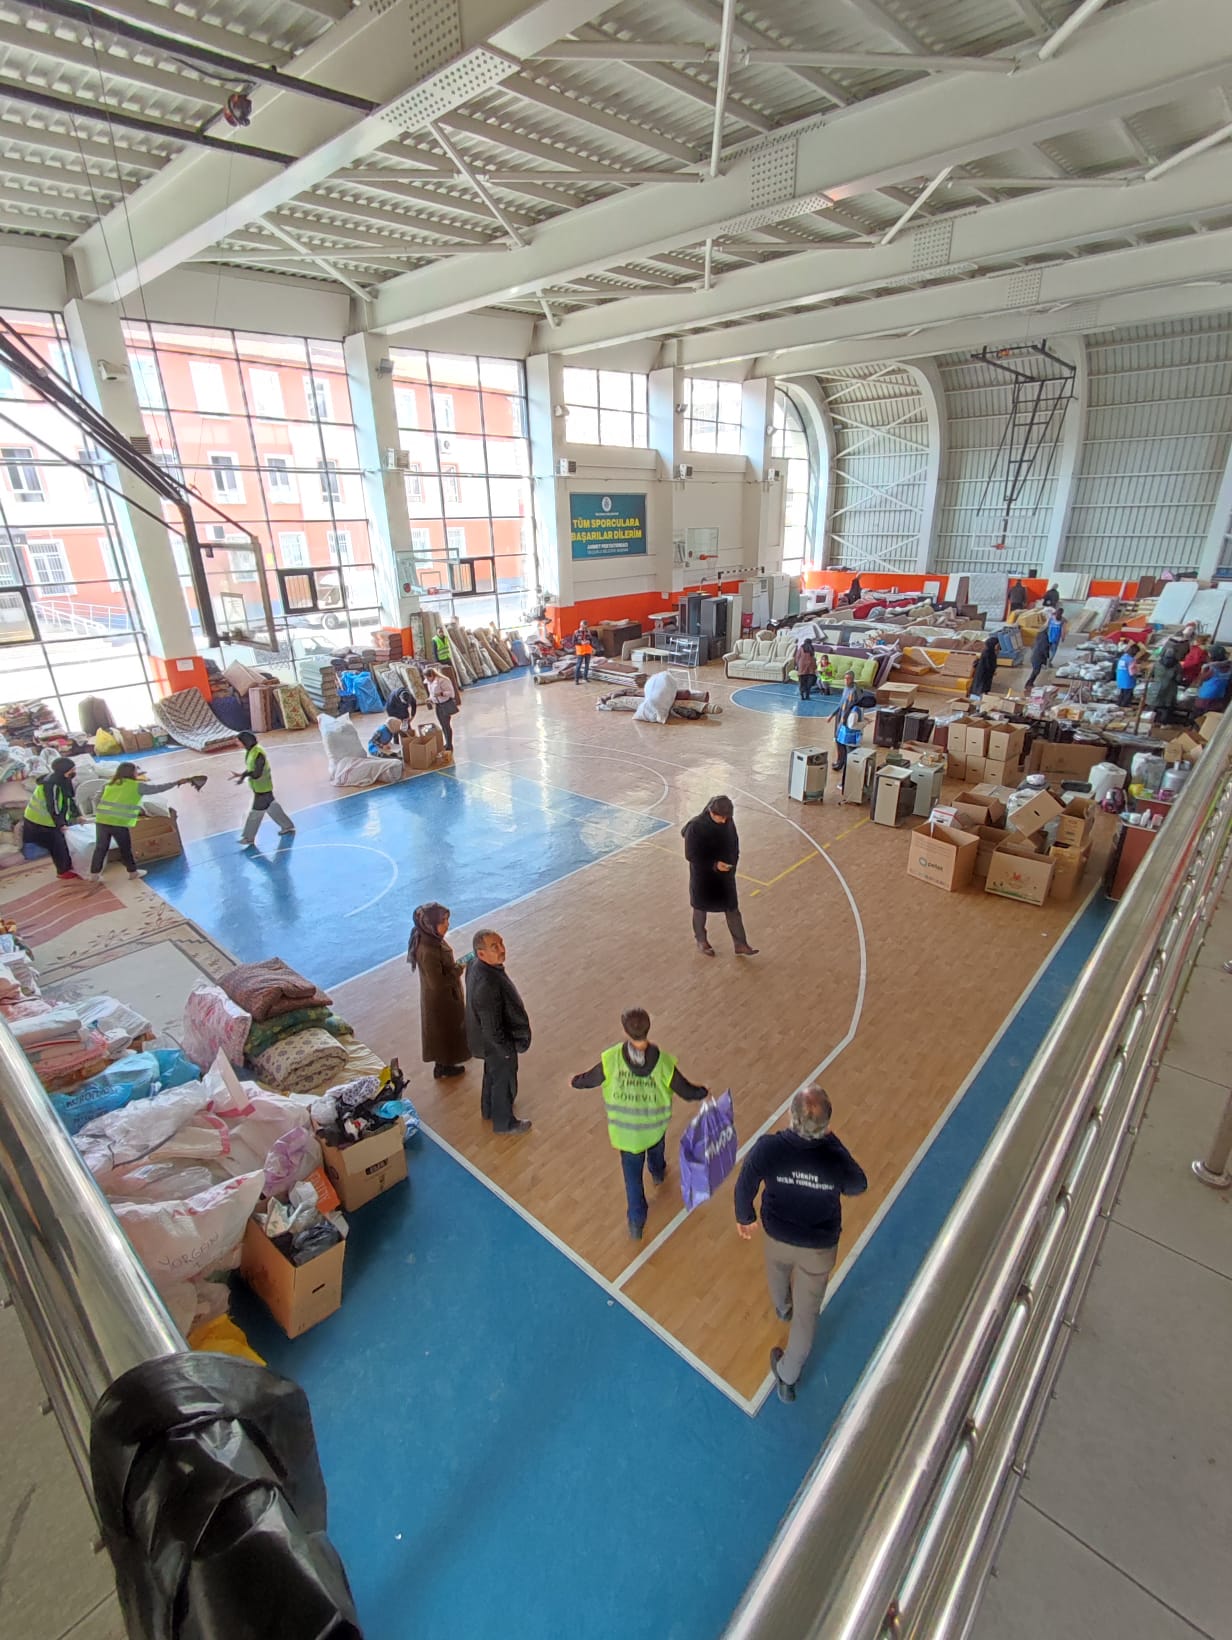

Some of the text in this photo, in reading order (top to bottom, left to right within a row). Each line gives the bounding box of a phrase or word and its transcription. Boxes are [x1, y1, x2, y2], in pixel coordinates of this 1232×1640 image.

[573, 517, 640, 528] TÜM SPORCULARA
[571, 528, 642, 543] BAŞARILAR DİLERİM
[792, 1169, 818, 1182] TÜRKİYE
